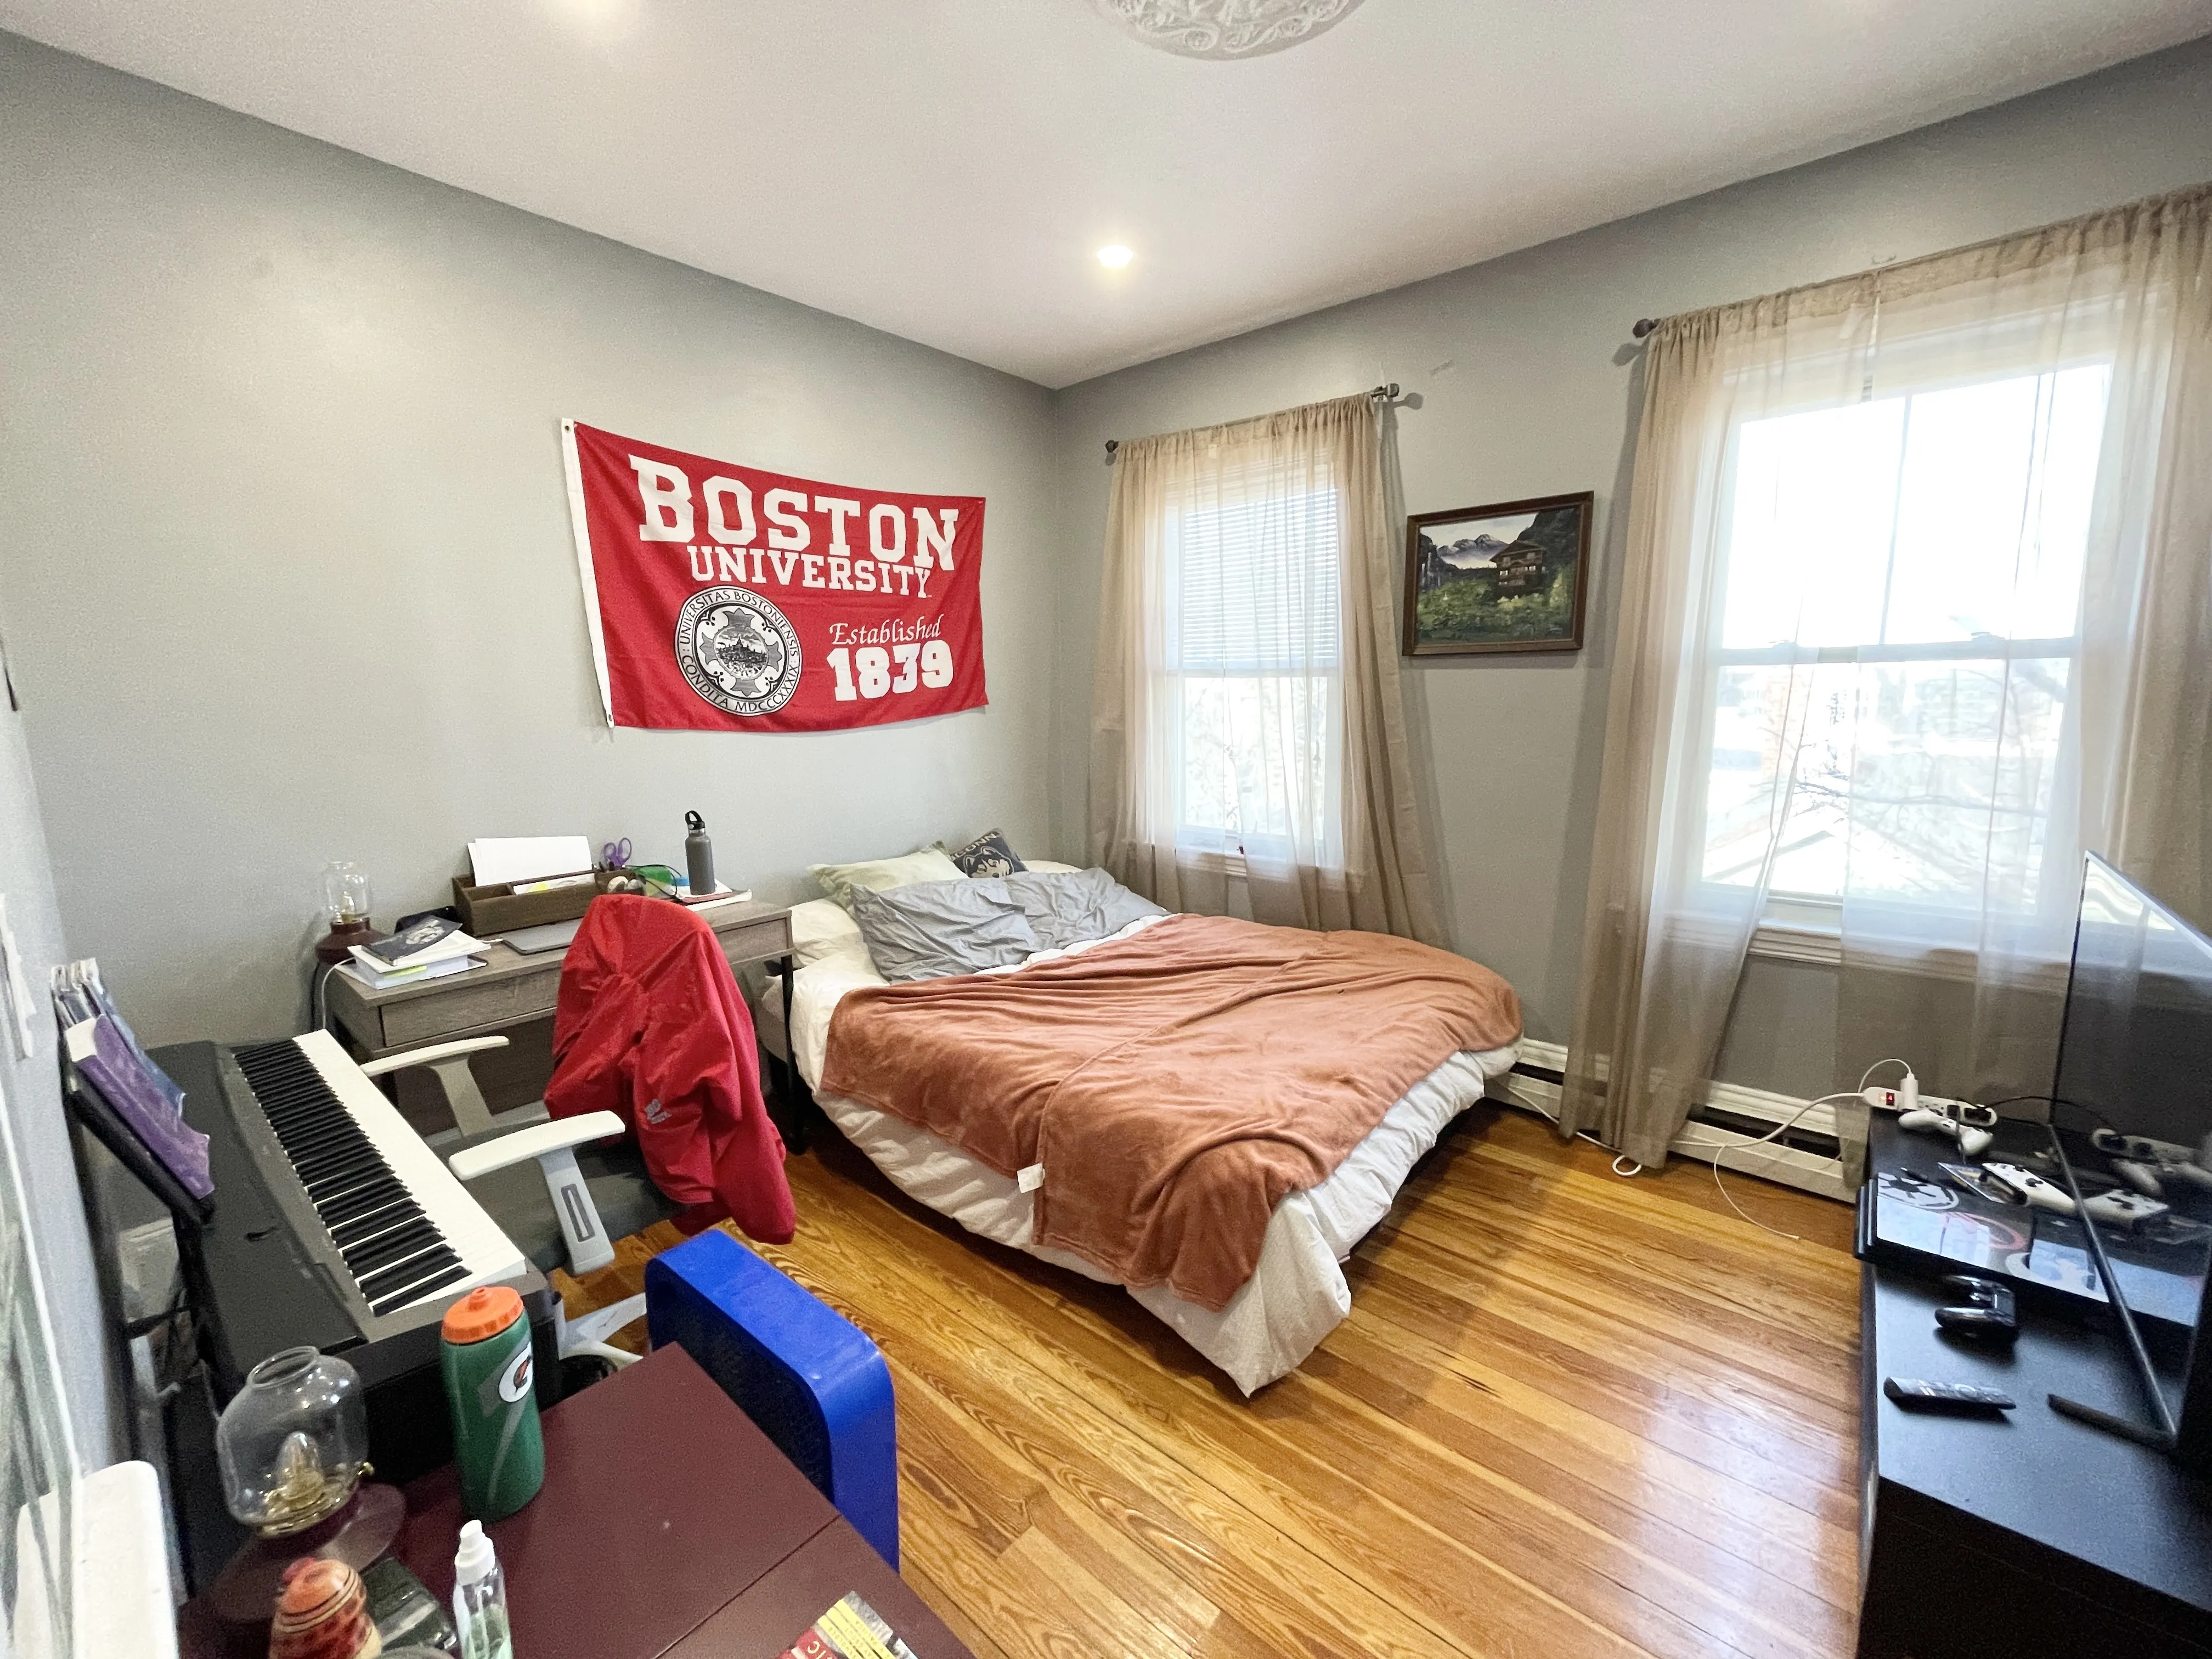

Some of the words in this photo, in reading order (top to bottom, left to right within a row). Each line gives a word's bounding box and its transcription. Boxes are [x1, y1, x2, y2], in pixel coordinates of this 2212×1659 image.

[628, 455, 959, 571] BOSTON
[687, 545, 932, 599] UNIVERSITY
[680, 590, 730, 645] UNIVERSITAS
[734, 591, 798, 657] BOSTONIENSIS
[830, 614, 944, 646] Established
[682, 655, 728, 709] CONDITA
[735, 665, 798, 712] MDCCCXXXIX
[826, 640, 954, 702] 1839
